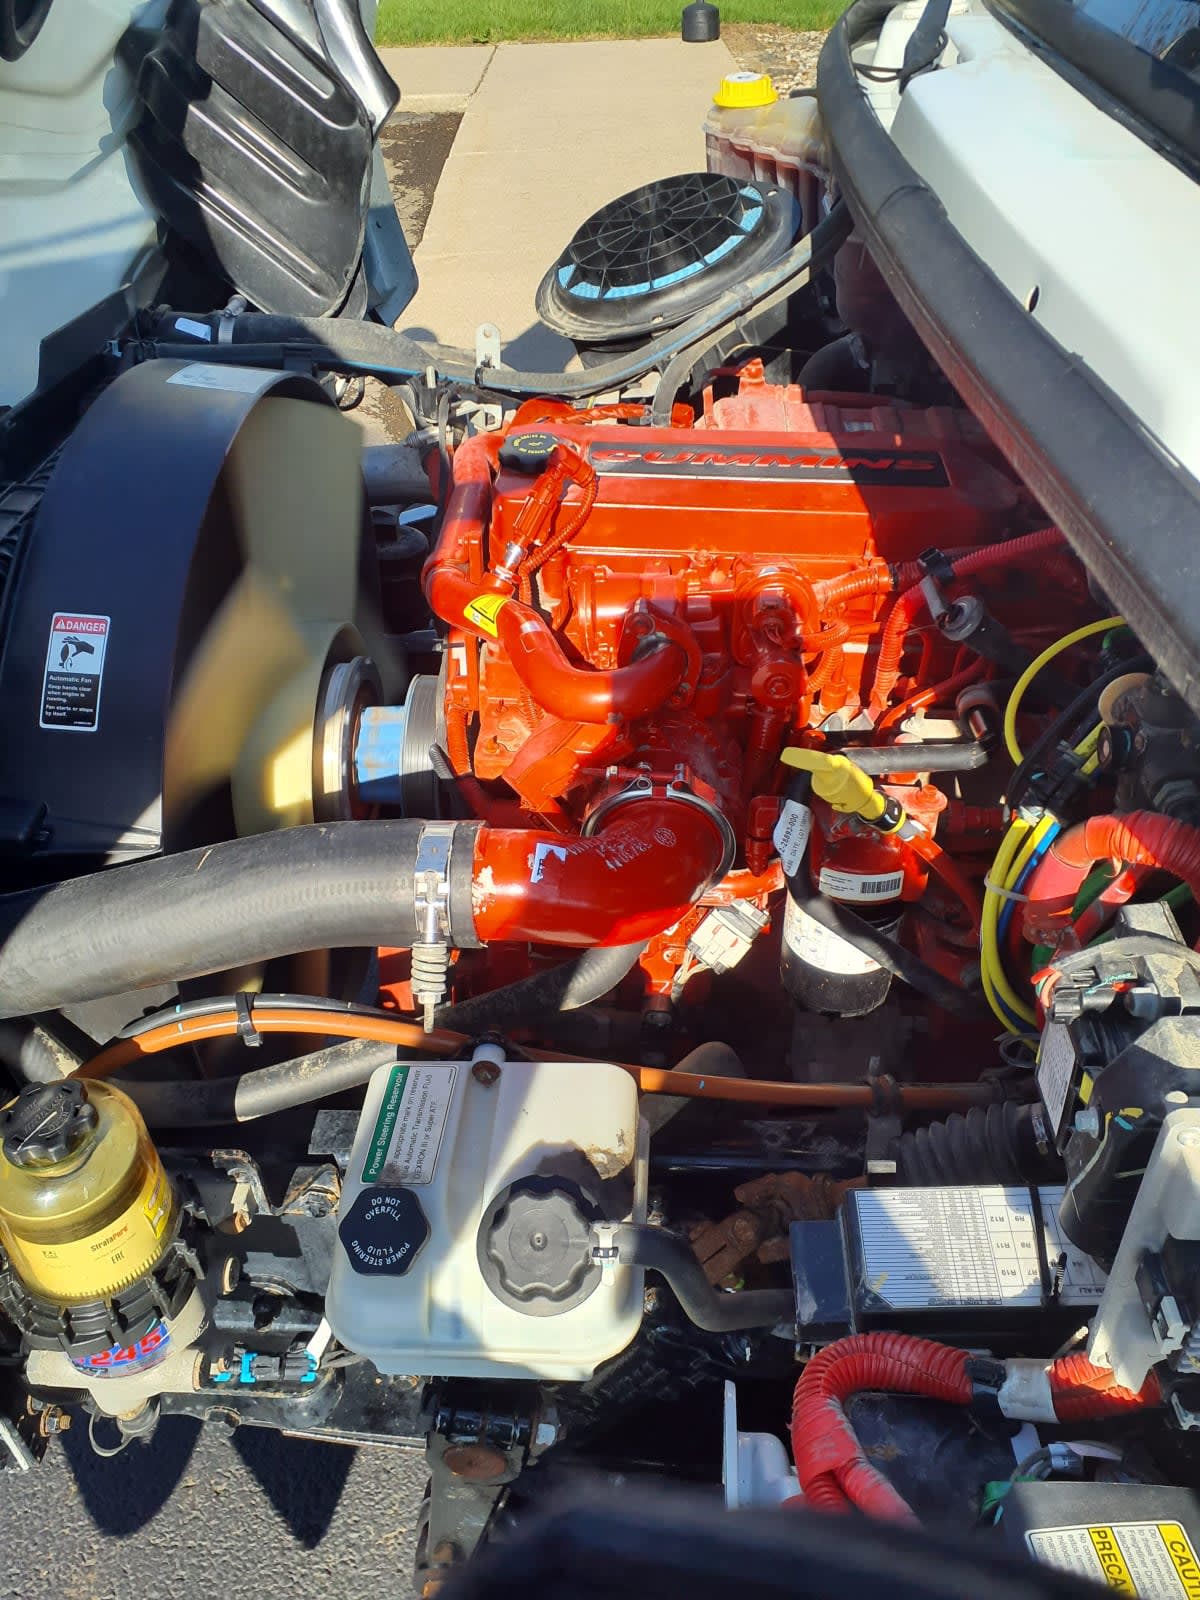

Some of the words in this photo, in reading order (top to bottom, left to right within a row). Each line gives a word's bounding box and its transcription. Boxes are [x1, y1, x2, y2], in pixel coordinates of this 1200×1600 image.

[591, 447, 937, 472] CUMMINS
[66, 620, 106, 632] DANGER
[369, 1148, 383, 1174] Power
[378, 1111, 395, 1146] Steering
[387, 1072, 404, 1110] Reservoir
[394, 1121, 407, 1158] appropriate
[408, 1097, 414, 1106] on
[411, 1069, 421, 1095] reservoir
[406, 1131, 418, 1164] Automatic
[412, 1087, 428, 1130] Transmission
[423, 1074, 432, 1090] Fluid
[426, 1115, 435, 1133] Super
[425, 1131, 430, 1139] or
[414, 1149, 426, 1179] DEXRON
[365, 1206, 401, 1221] OVERFILL
[372, 1197, 382, 1206] DO
[385, 1197, 400, 1206] NOT
[90, 1224, 128, 1252] StrataPore
[352, 1240, 383, 1266] STEERING
[368, 1246, 393, 1256] FLUID
[386, 1243, 410, 1264] POWER
[91, 1328, 161, 1366] 245
[1078, 1533, 1087, 1543] No
[1117, 1530, 1138, 1568] attachment
[1128, 1529, 1149, 1567] Freightliner
[1142, 1537, 1155, 1557] these
[1148, 1528, 1158, 1538] Do
[1154, 1540, 1163, 1551] not
[1160, 1553, 1176, 1581] connect
[1170, 1581, 1186, 1600] jump
